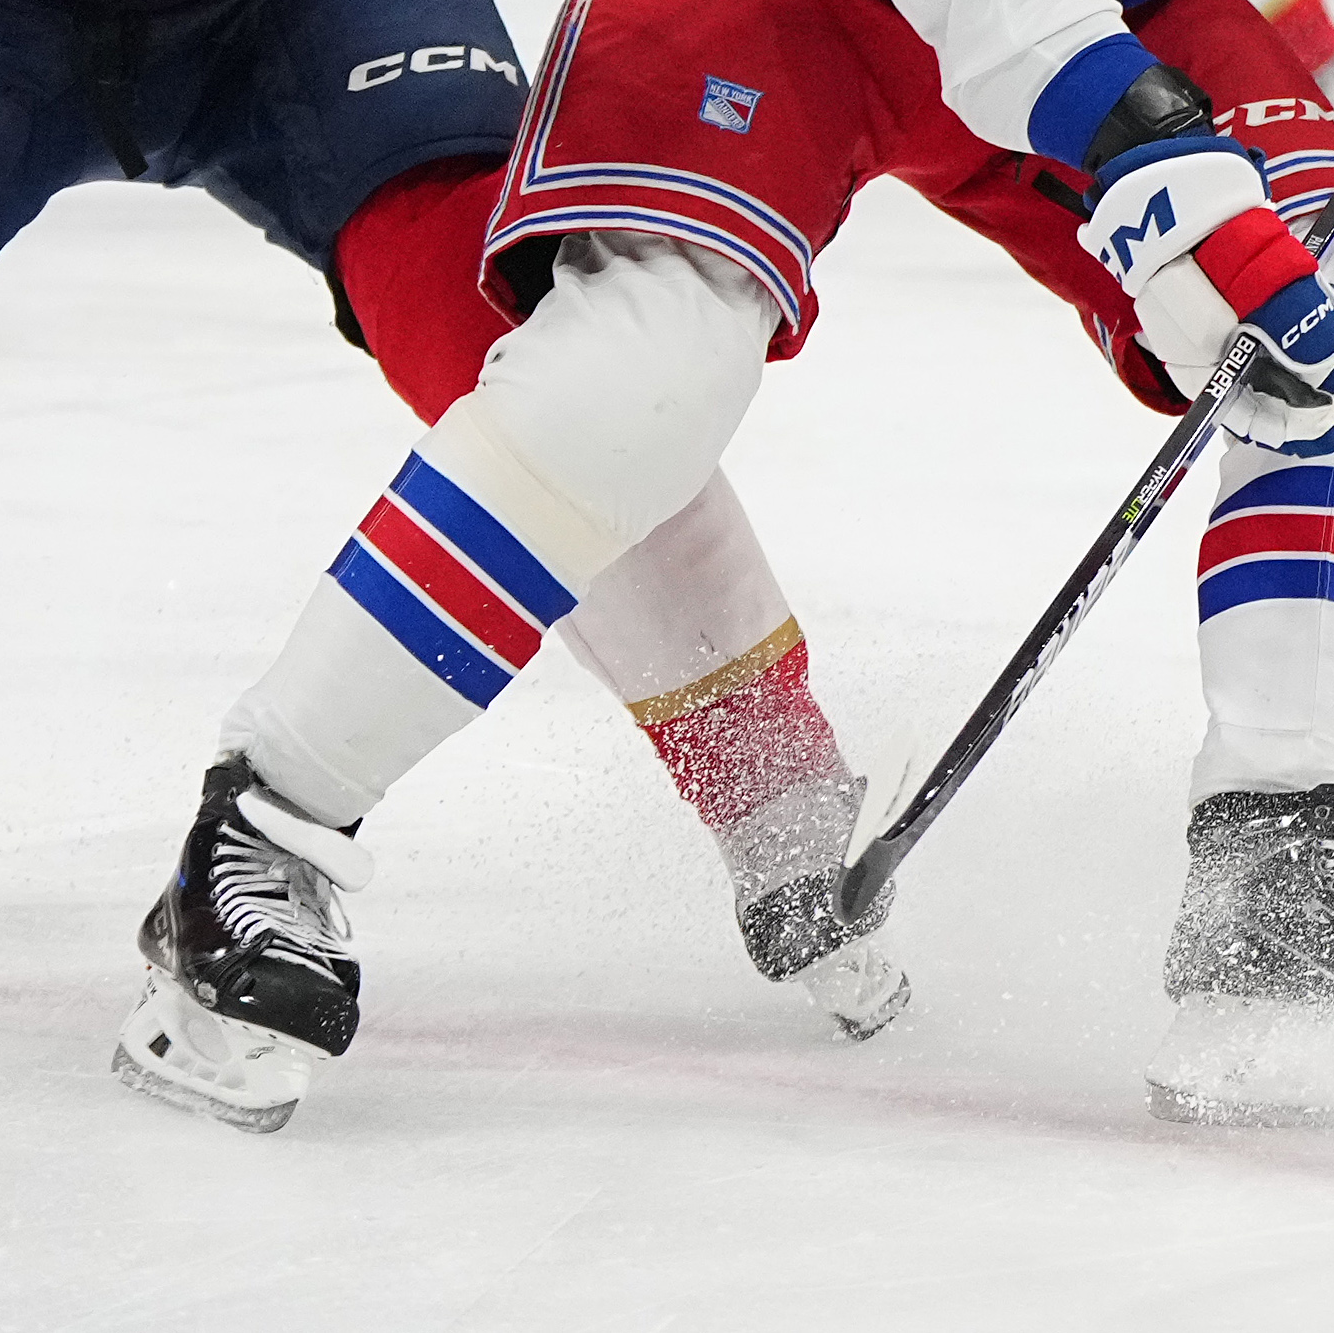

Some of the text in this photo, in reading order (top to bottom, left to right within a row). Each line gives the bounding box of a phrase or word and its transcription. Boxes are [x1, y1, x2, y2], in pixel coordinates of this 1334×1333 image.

[347, 45, 519, 92] CCM
[1281, 298, 1334, 350] CCM
[1204, 334, 1257, 399] BAUER
[1121, 465, 1168, 524] HYPERLITE
